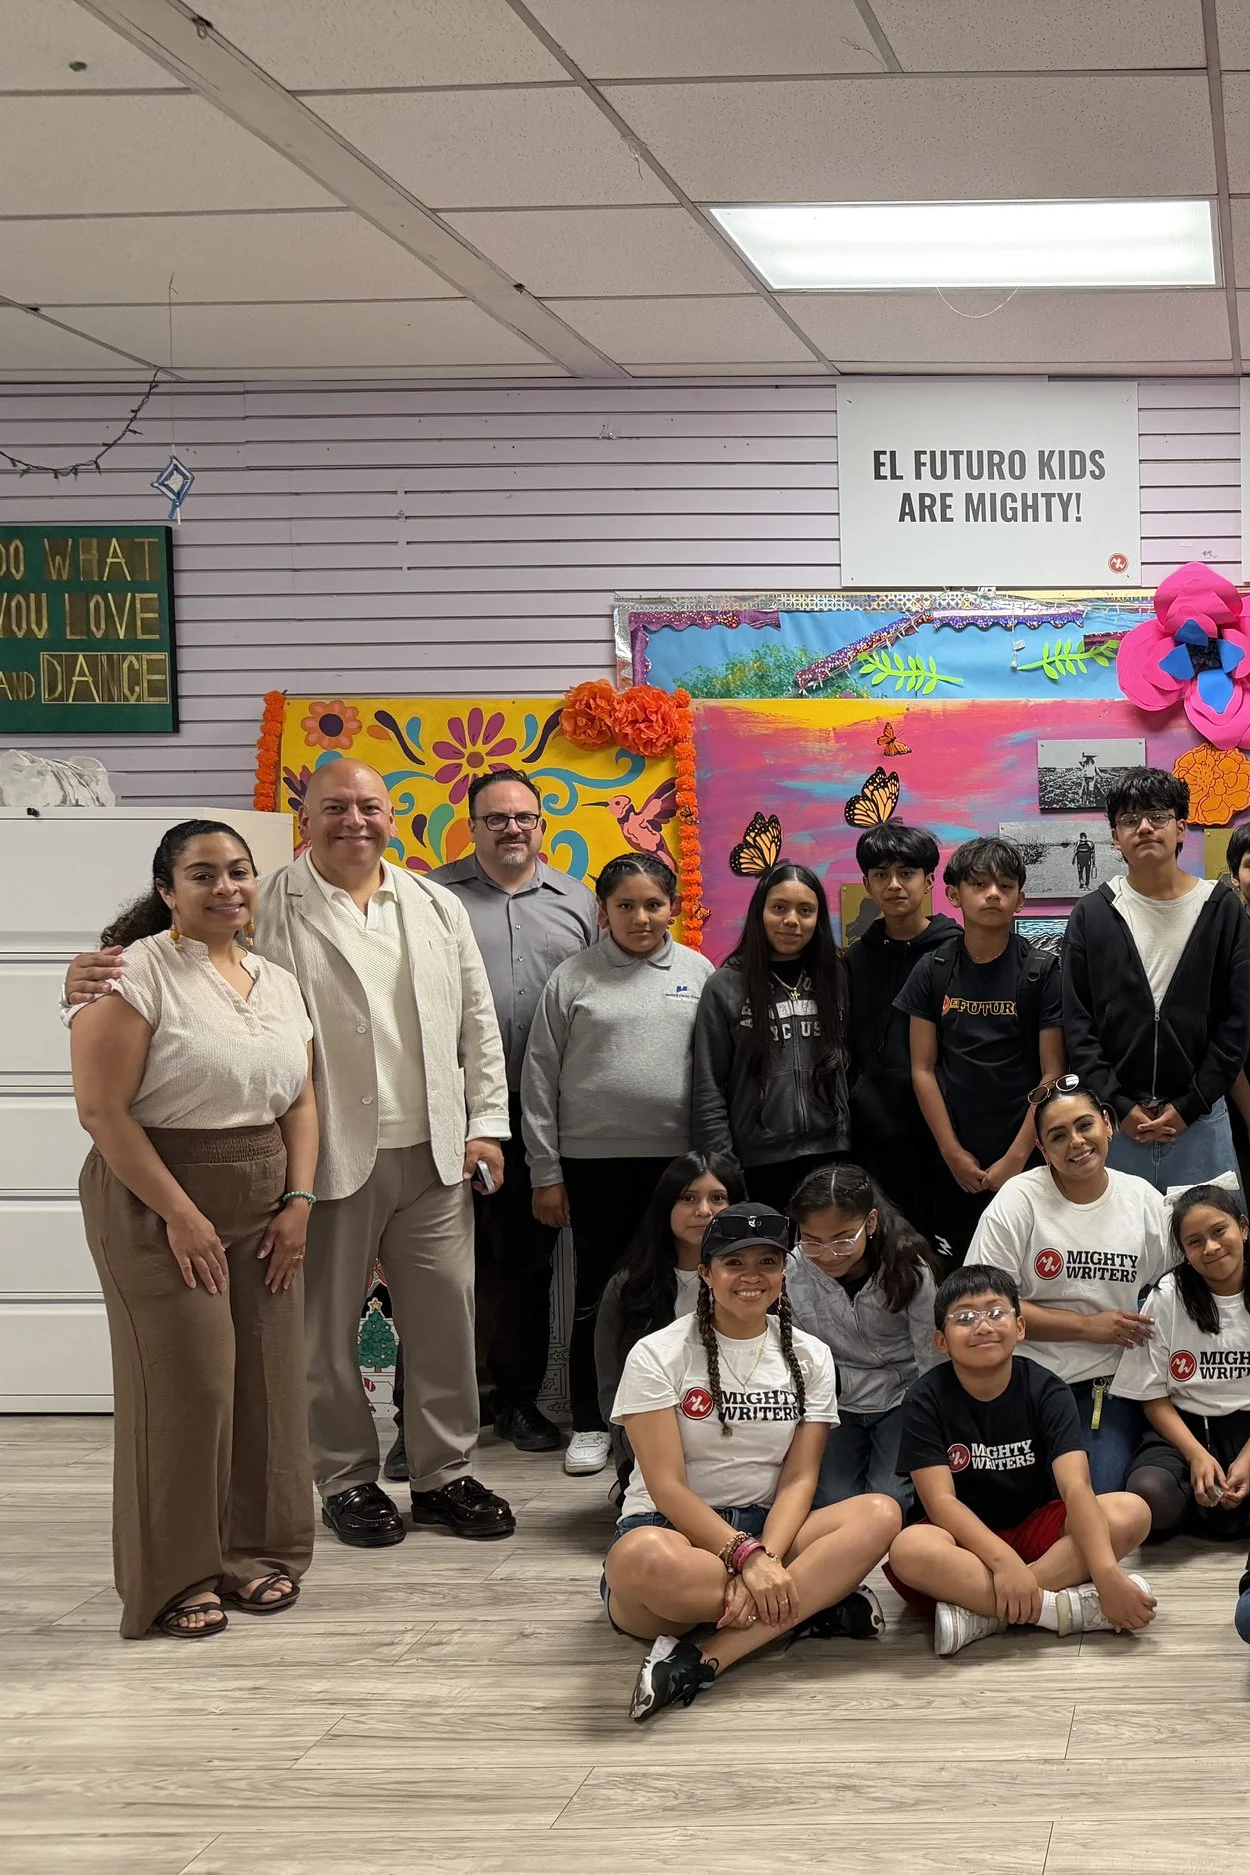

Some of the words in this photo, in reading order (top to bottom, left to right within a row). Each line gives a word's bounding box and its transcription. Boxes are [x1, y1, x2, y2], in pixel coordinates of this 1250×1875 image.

[873, 450, 904, 480] EL
[914, 449, 1027, 481] FUTURO
[1038, 449, 1106, 481] KIDS
[898, 492, 954, 523] ARE
[964, 491, 1082, 523] MIGHTY!
[43, 537, 159, 581] WHAT
[64, 592, 160, 639] LOVE
[43, 653, 168, 703] DANCE
[1066, 1250, 1139, 1269] MIGHTY
[1066, 1266, 1138, 1284] WRITERS
